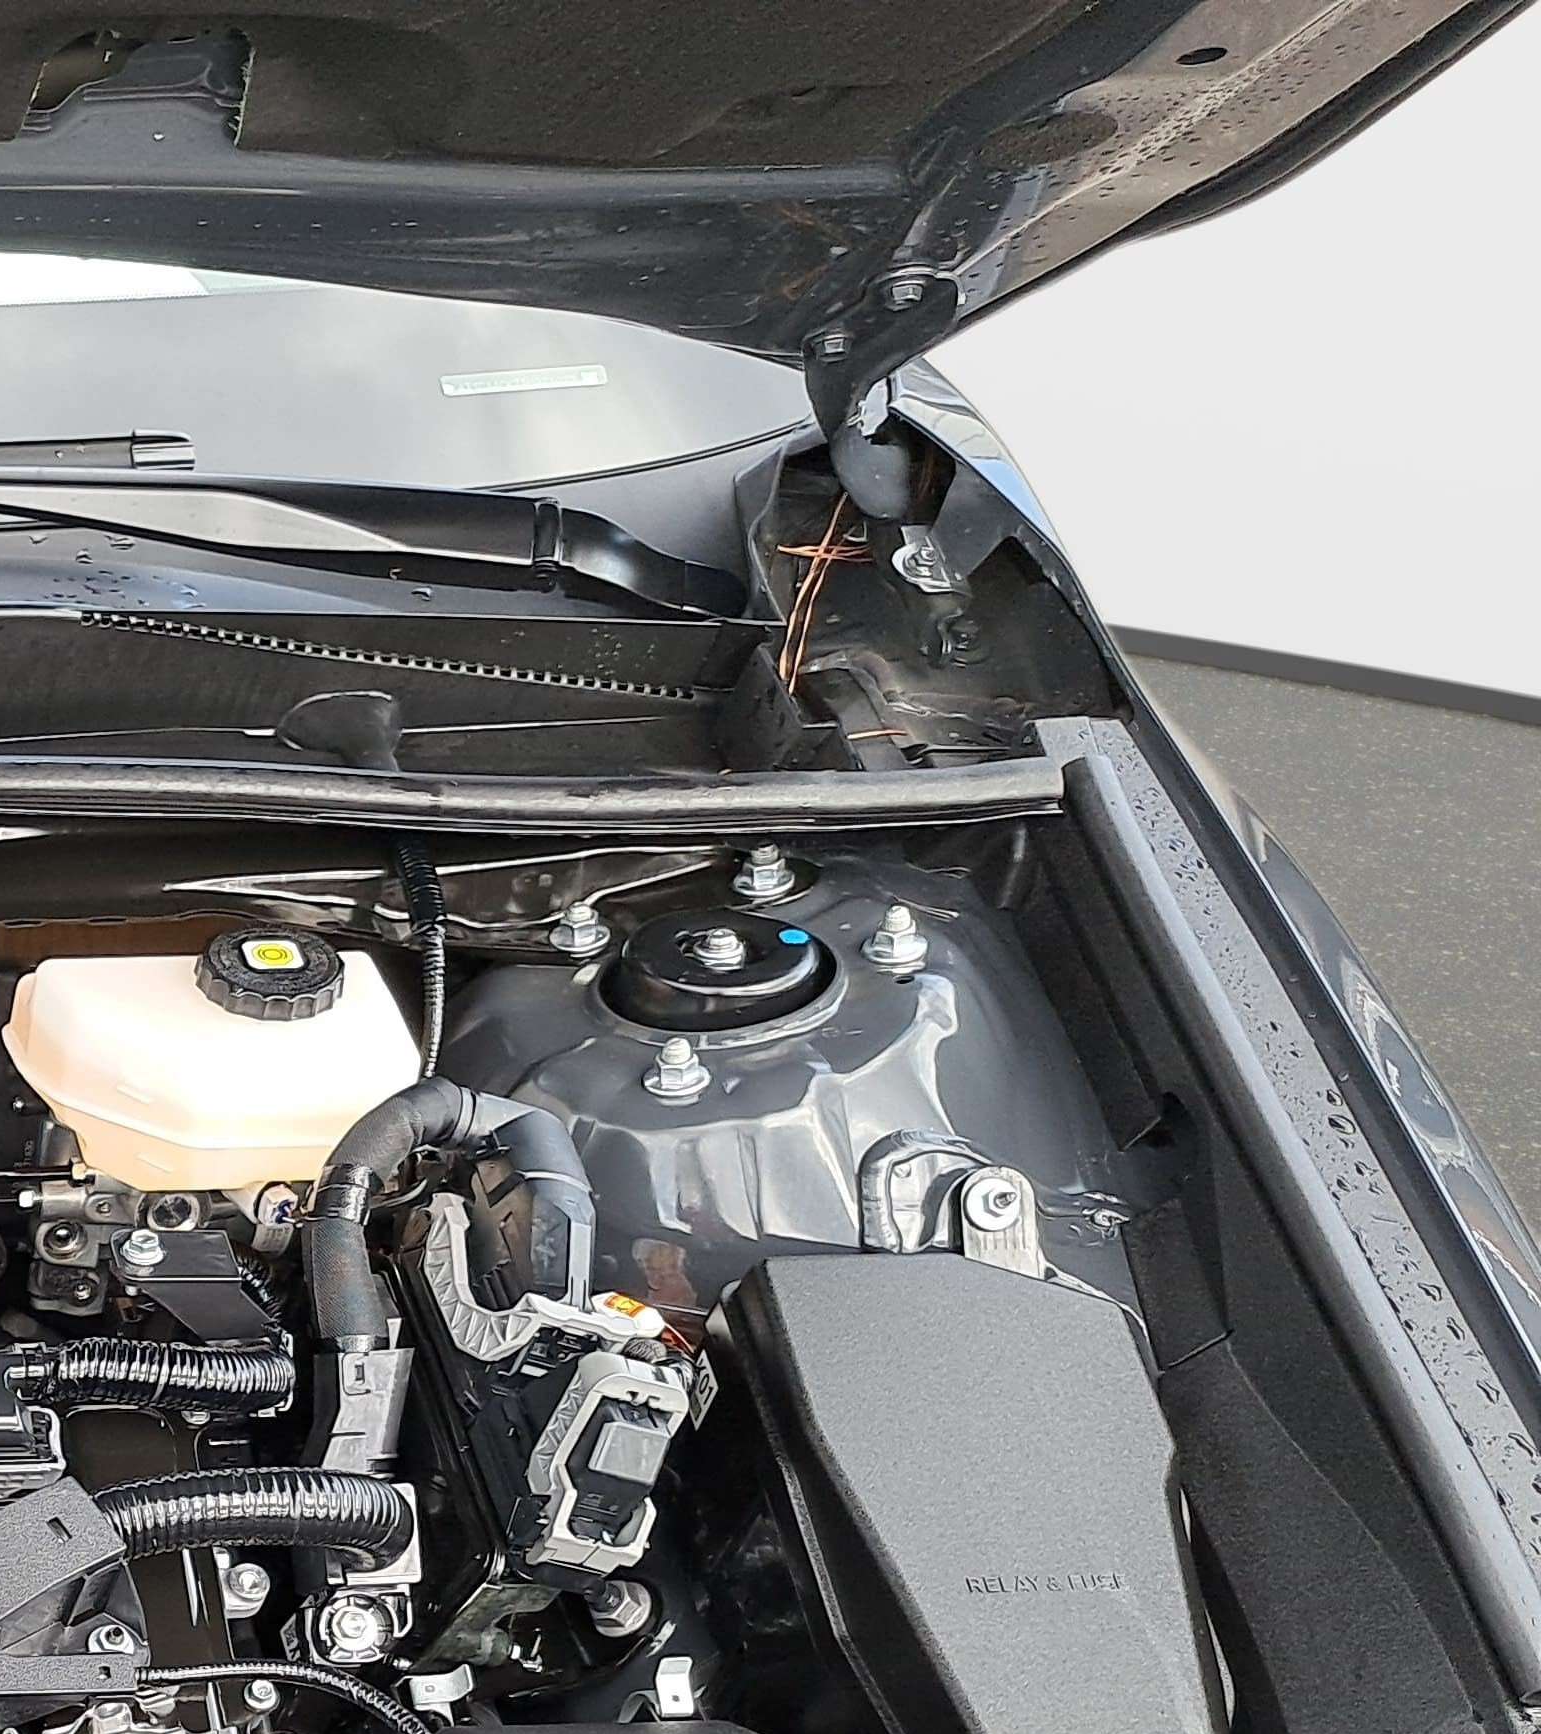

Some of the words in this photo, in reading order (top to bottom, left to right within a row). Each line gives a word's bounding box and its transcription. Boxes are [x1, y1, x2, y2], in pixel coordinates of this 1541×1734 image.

[965, 1574, 1038, 1594] RELAY
[1046, 1574, 1062, 1592] &
[1067, 1572, 1125, 1593] FUSE
